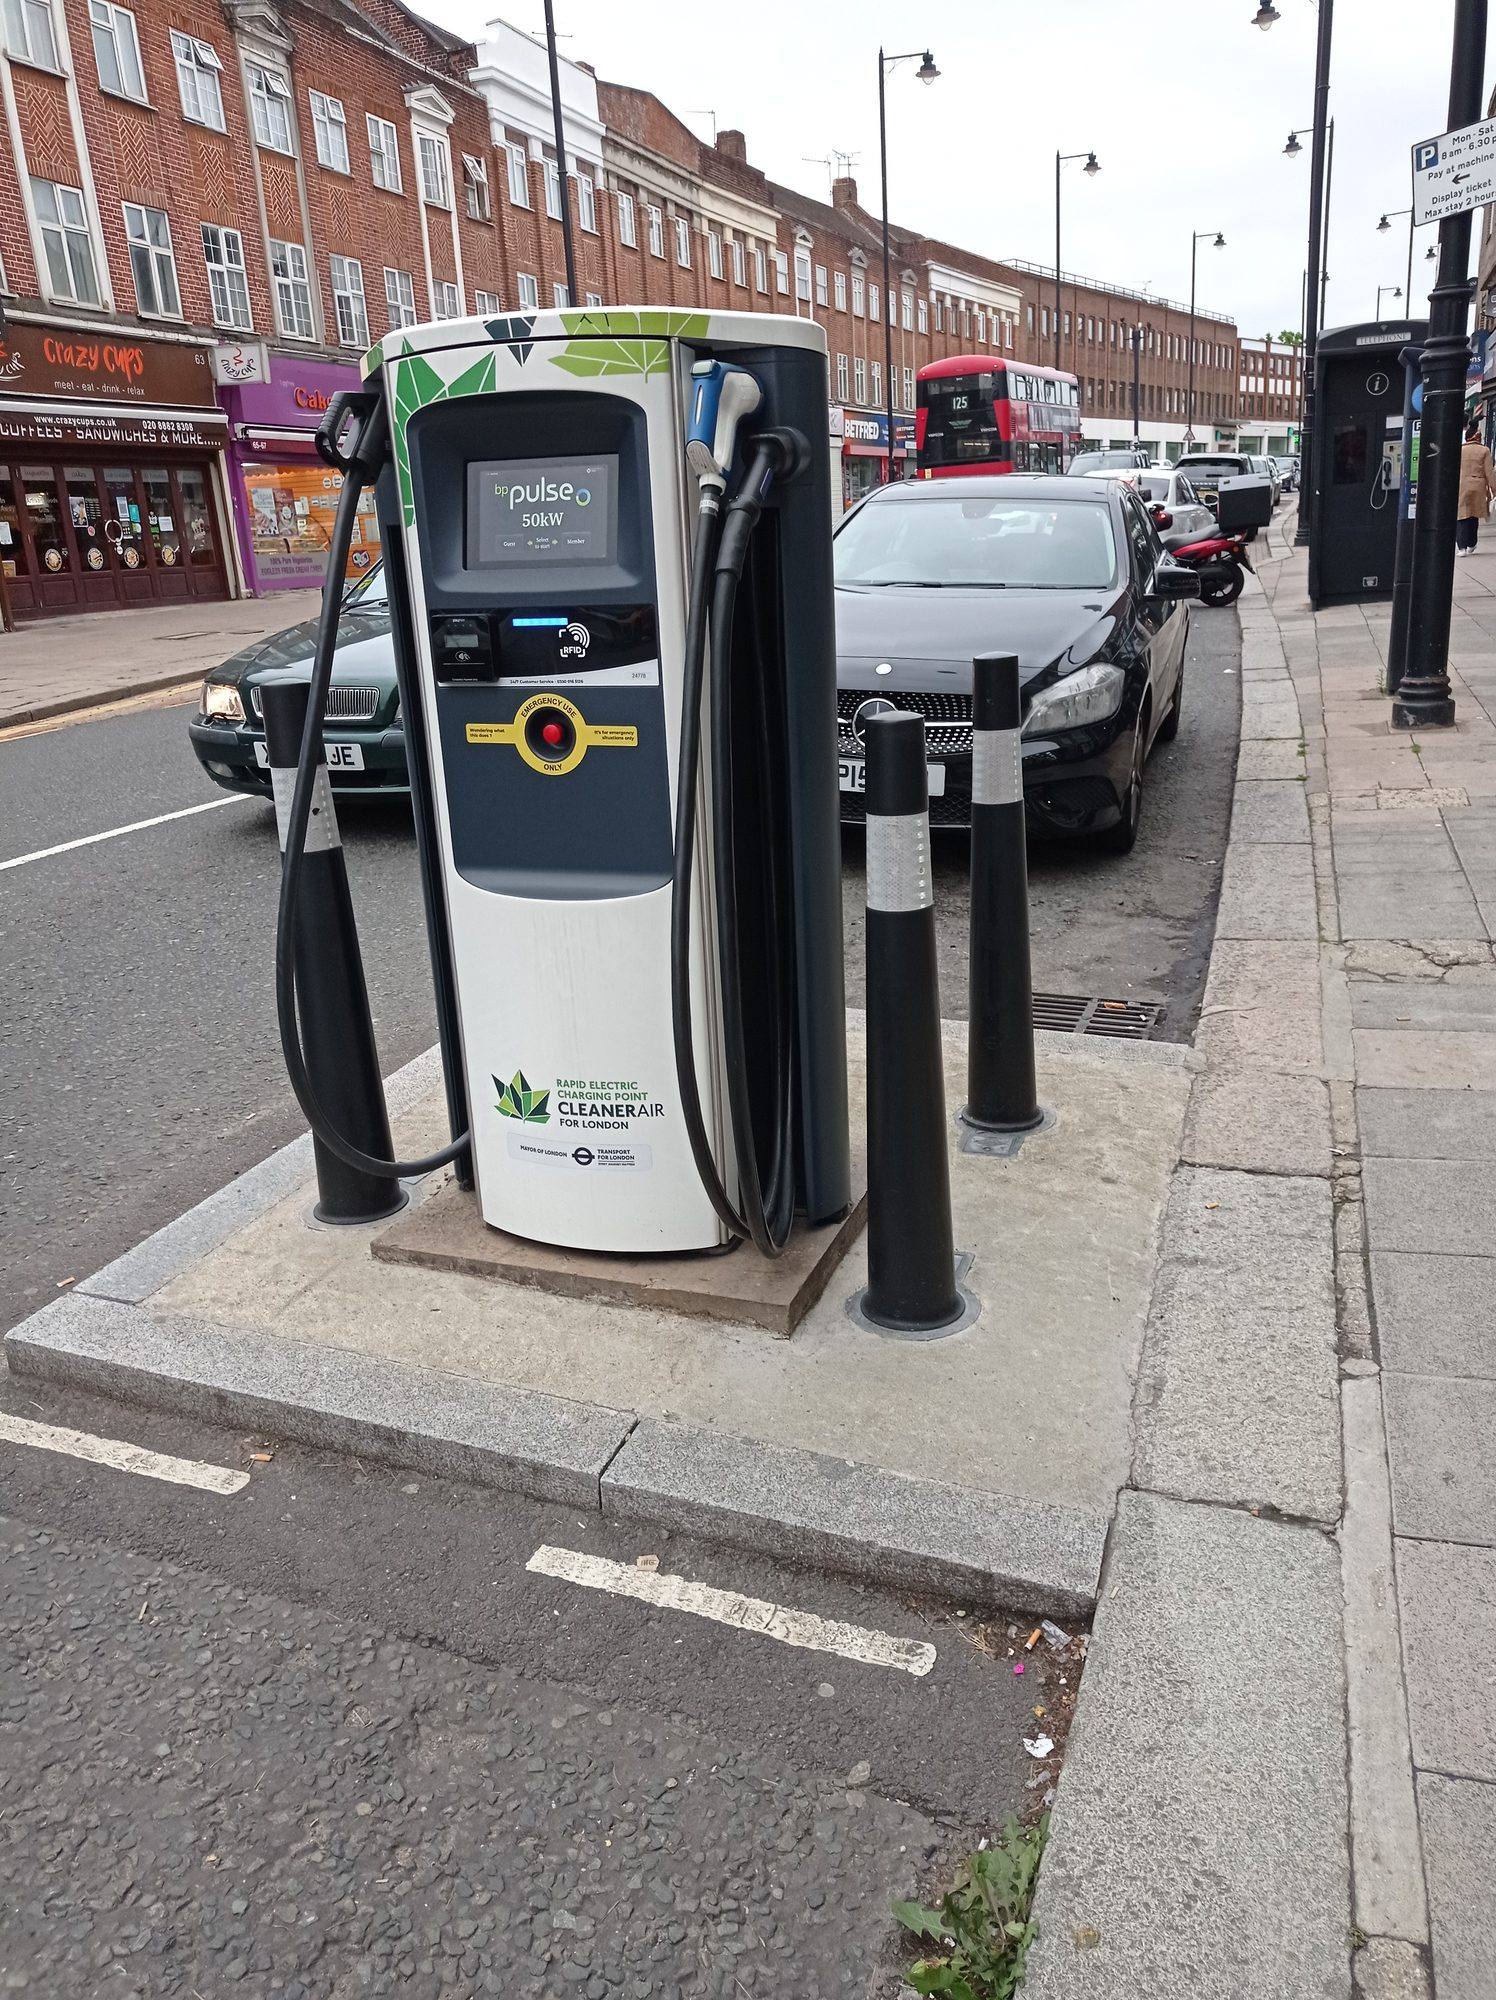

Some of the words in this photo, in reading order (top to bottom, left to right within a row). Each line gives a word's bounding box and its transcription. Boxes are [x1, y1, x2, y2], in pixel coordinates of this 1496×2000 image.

[1452, 133, 1471, 146] Mon
[1478, 124, 1494, 136] Sat
[1421, 146, 1436, 168] P
[1428, 169, 1443, 181] Pay
[1446, 165, 1455, 174] at
[1457, 152, 1494, 170] machine
[1431, 189, 1463, 205] Display
[1466, 179, 1492, 193] ticket
[1424, 209, 1442, 219] Max
[1445, 200, 1463, 213] stay
[1466, 197, 1472, 206] 2
[194, 354, 205, 365] 63
[54, 381, 75, 390] meet
[81, 383, 95, 392] eat
[101, 384, 120, 394] drink
[127, 387, 145, 396] relax
[952, 396, 968, 410] 125
[34, 416, 117, 427] www.crazycups.co.uk
[142, 420, 156, 430] 020
[157, 421, 175, 431] 8882
[845, 419, 879, 440] BETFRED
[161, 431, 169, 443] &
[252, 441, 267, 450] 65-67
[494, 483, 509, 497] bp
[509, 476, 574, 510] pulse
[522, 512, 564, 528] 50kW
[563, 646, 582, 654] RFID
[520, 697, 562, 719] EMERGENCY
[562, 703, 577, 719] USE
[543, 763, 563, 772] ONLY
[556, 1078, 586, 1090] RAPID
[589, 1081, 638, 1090] ELECTRIC
[557, 1090, 612, 1101] CHARGING
[614, 1092, 648, 1101] POINT
[559, 1118, 579, 1128] FOR
[582, 1120, 629, 1130] LONDON
[520, 1145, 536, 1153] MAYOR
[544, 1149, 568, 1158] LONDON
